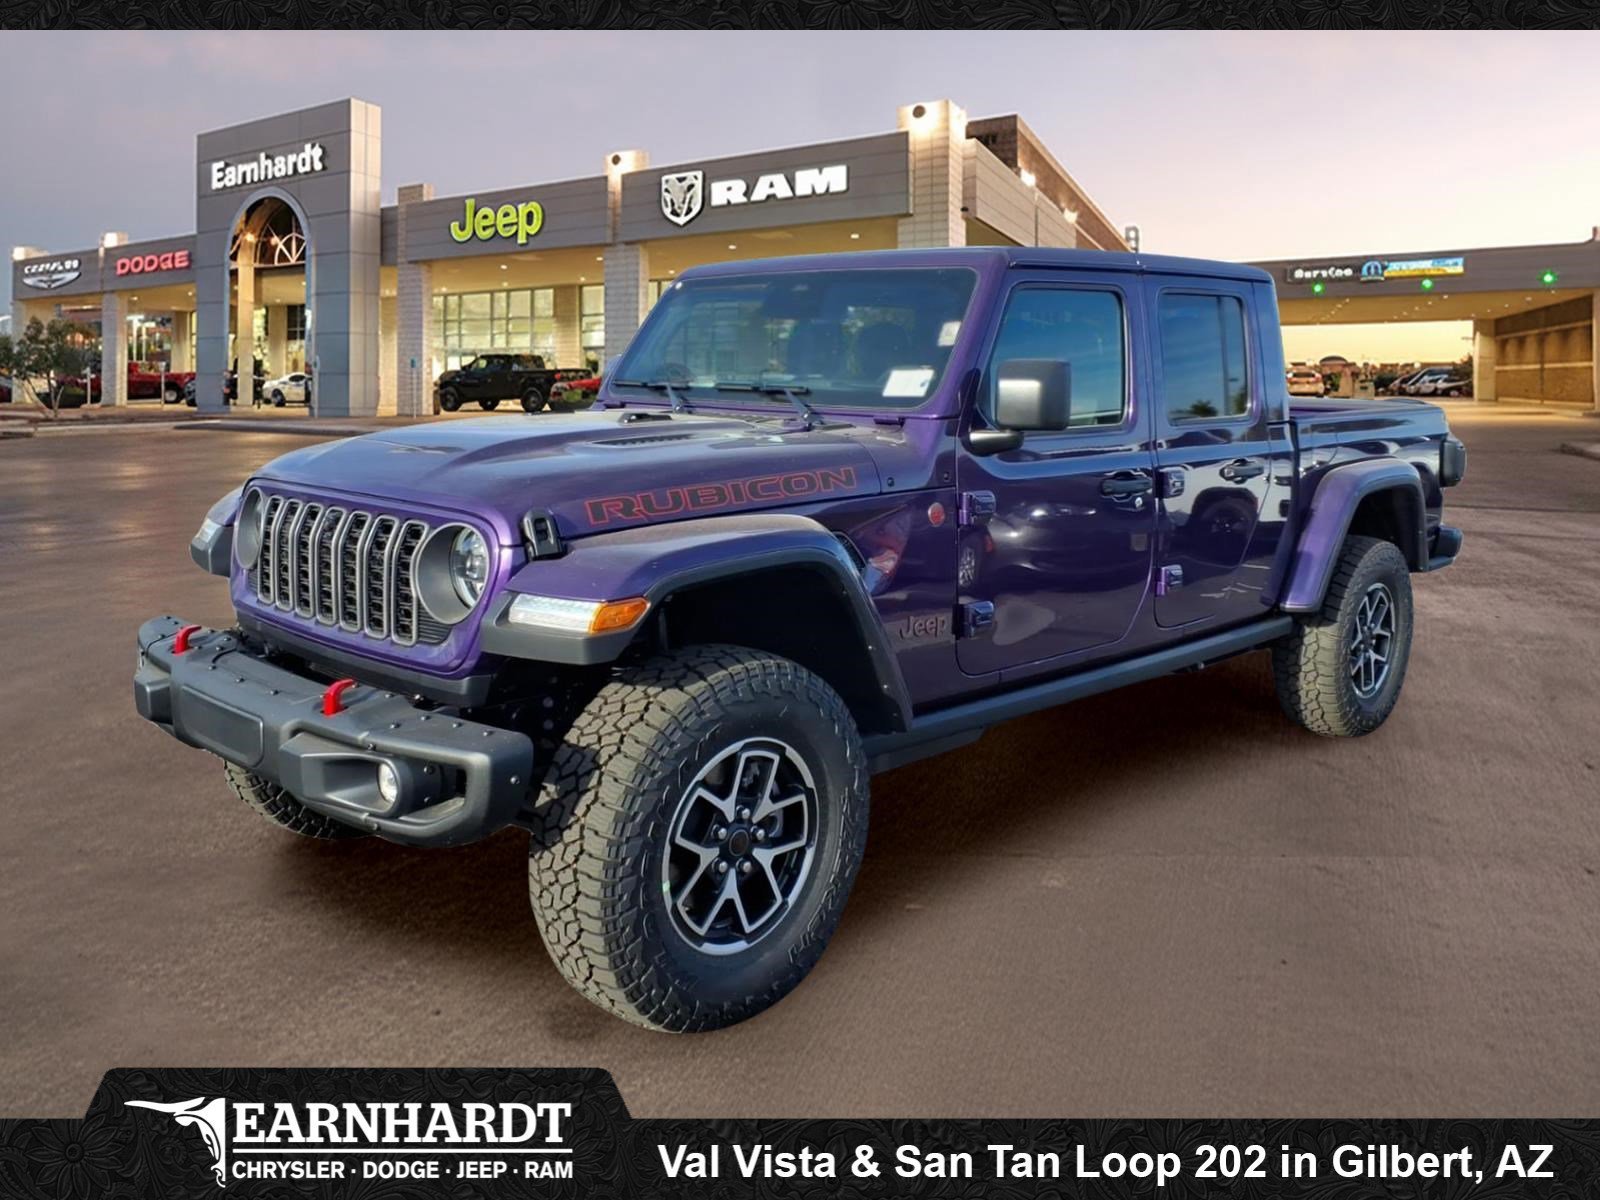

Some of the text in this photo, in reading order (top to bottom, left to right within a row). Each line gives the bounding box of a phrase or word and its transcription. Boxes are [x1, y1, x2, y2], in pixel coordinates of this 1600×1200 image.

[211, 142, 324, 190] Earnhardt
[710, 164, 849, 208] RAM
[449, 198, 544, 245] Jeep
[115, 250, 190, 276] DODGE
[585, 467, 857, 526] RUBICON
[899, 614, 947, 640] Jeep
